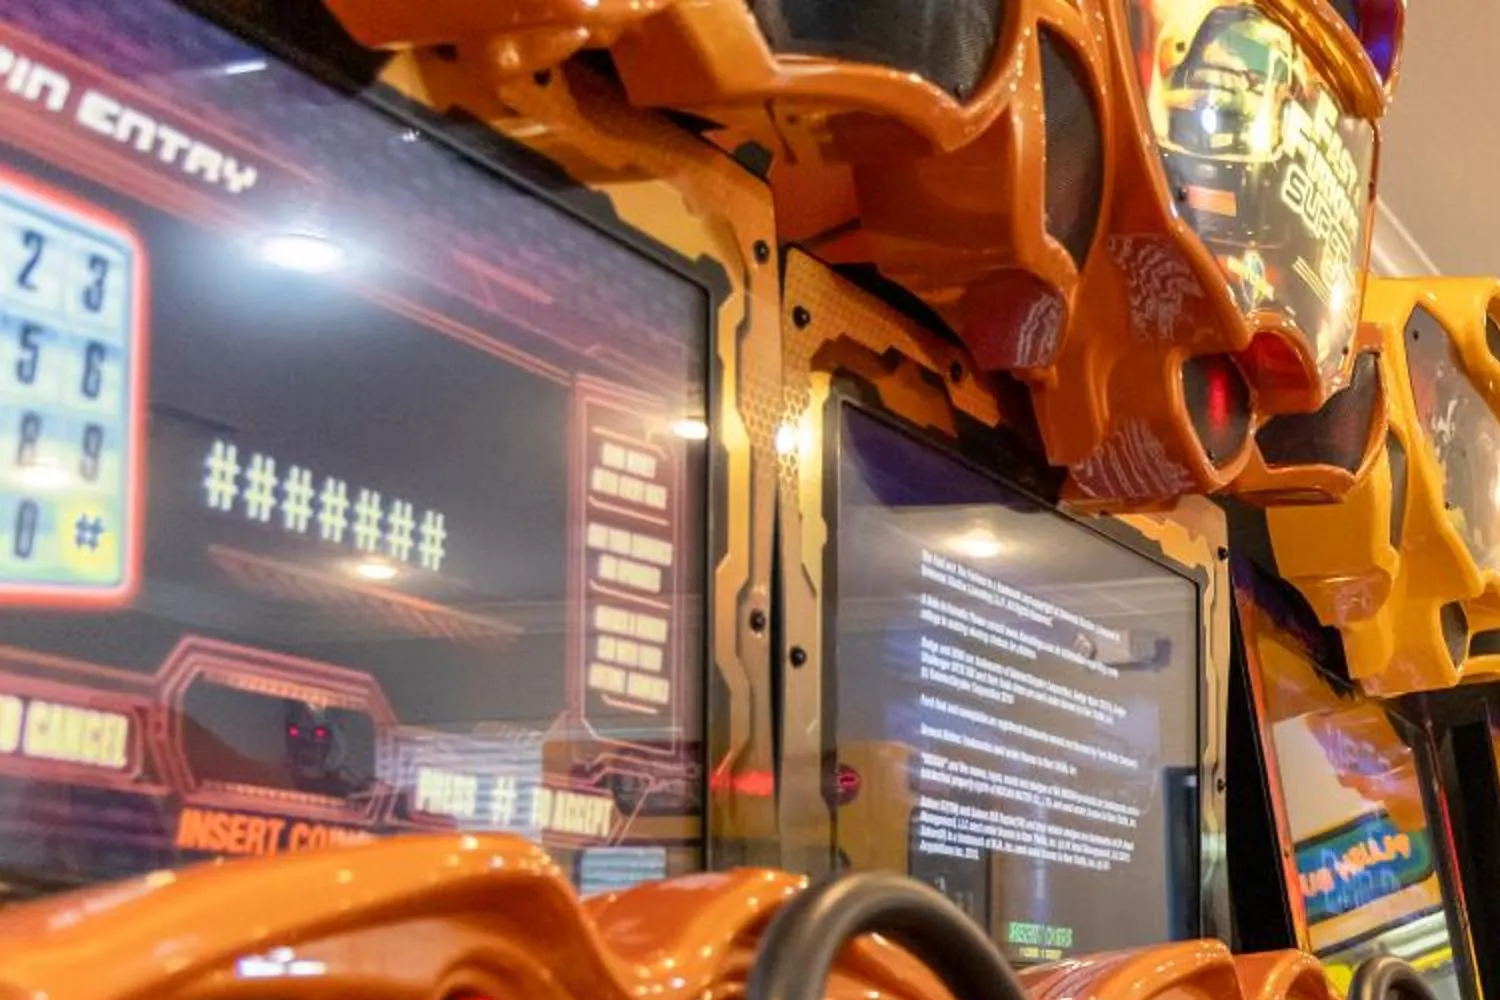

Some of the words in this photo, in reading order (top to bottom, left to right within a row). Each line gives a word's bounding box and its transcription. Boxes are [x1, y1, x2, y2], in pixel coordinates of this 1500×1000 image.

[77, 88, 257, 193] ENTRY
[17, 229, 45, 292] 2
[82, 253, 109, 313] 3
[16, 322, 45, 385] 5
[81, 339, 106, 398] 6
[175, 806, 287, 859] INSERT
